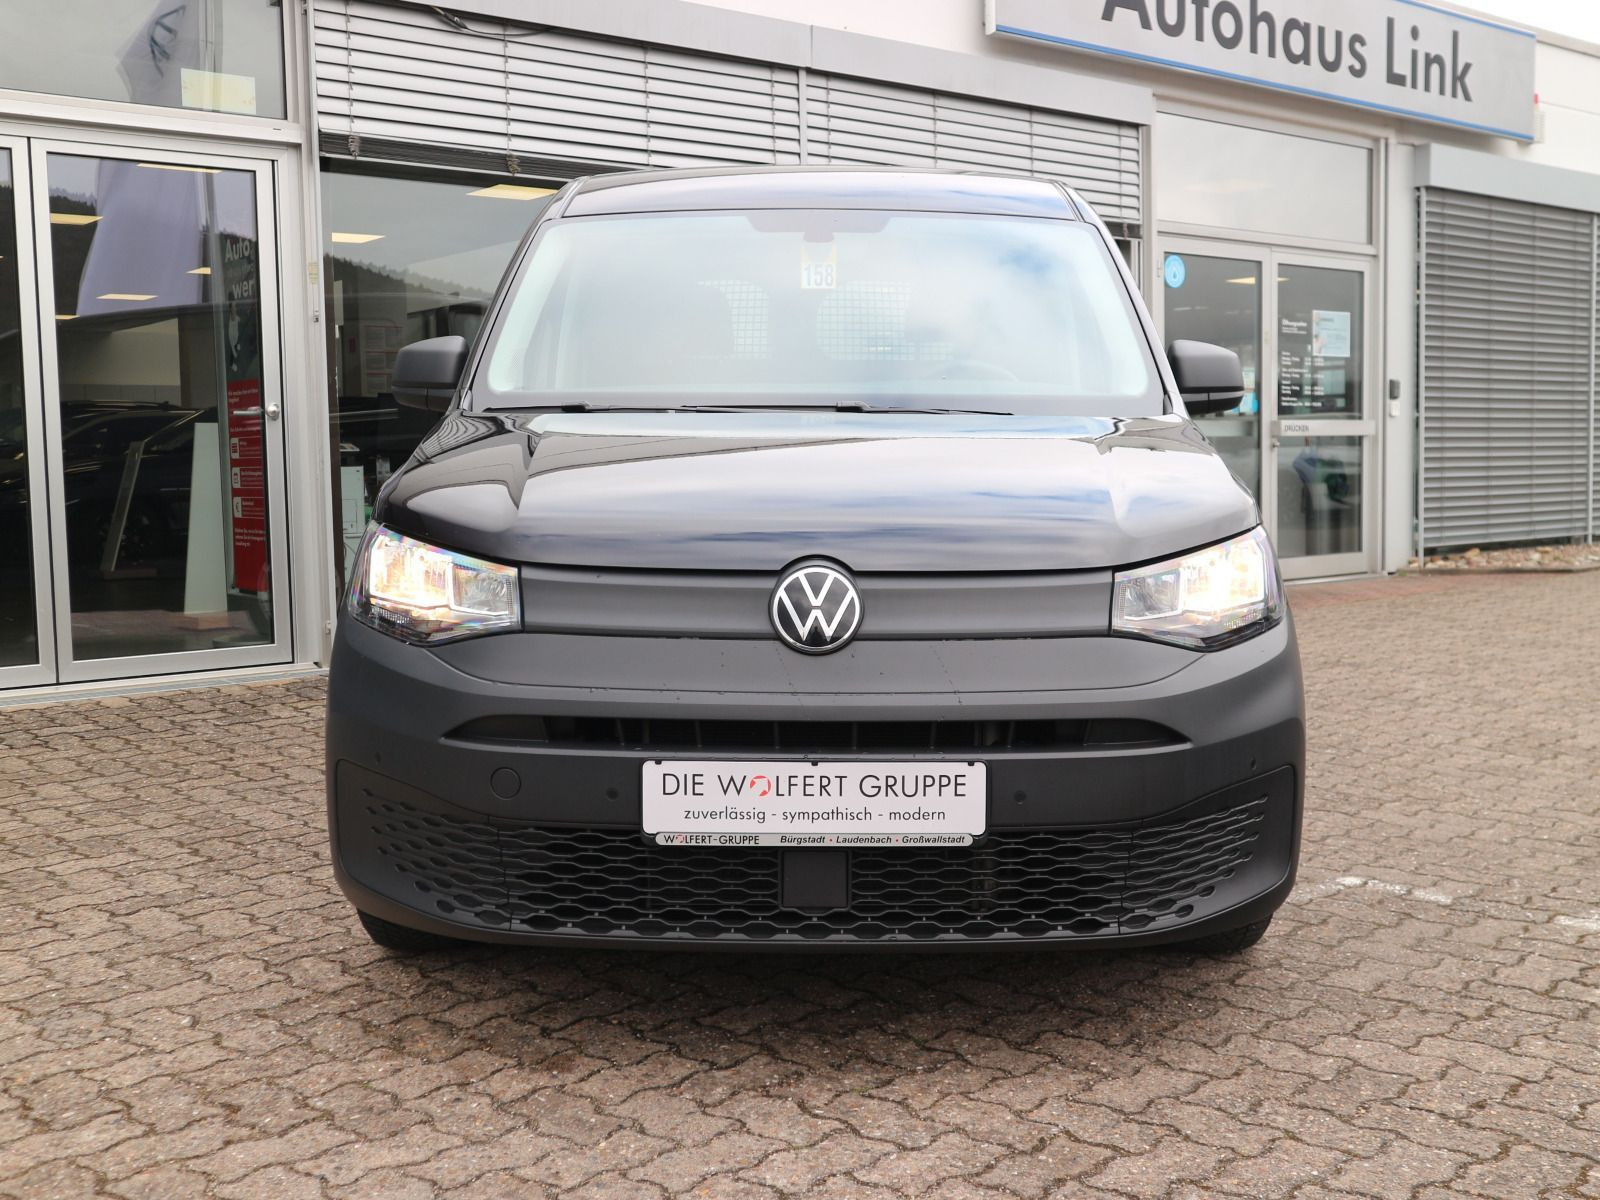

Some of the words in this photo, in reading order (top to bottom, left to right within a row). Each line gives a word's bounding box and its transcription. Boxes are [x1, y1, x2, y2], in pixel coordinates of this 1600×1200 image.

[1386, 16, 1473, 102] Link
[803, 263, 834, 287] 158
[777, 569, 856, 643] VW
[662, 773, 704, 796] DIE
[717, 774, 848, 797] WOLFERT
[859, 774, 967, 798] GRUPPE
[684, 806, 766, 824] zuverlässig
[782, 806, 872, 824] sympathisch
[889, 806, 946, 821] modern
[663, 834, 760, 845] WOLFERT-GRUPPE
[780, 835, 826, 845] Bürgstadt
[836, 835, 892, 844] Laudenbach
[902, 835, 965, 844] Großwallstadt
